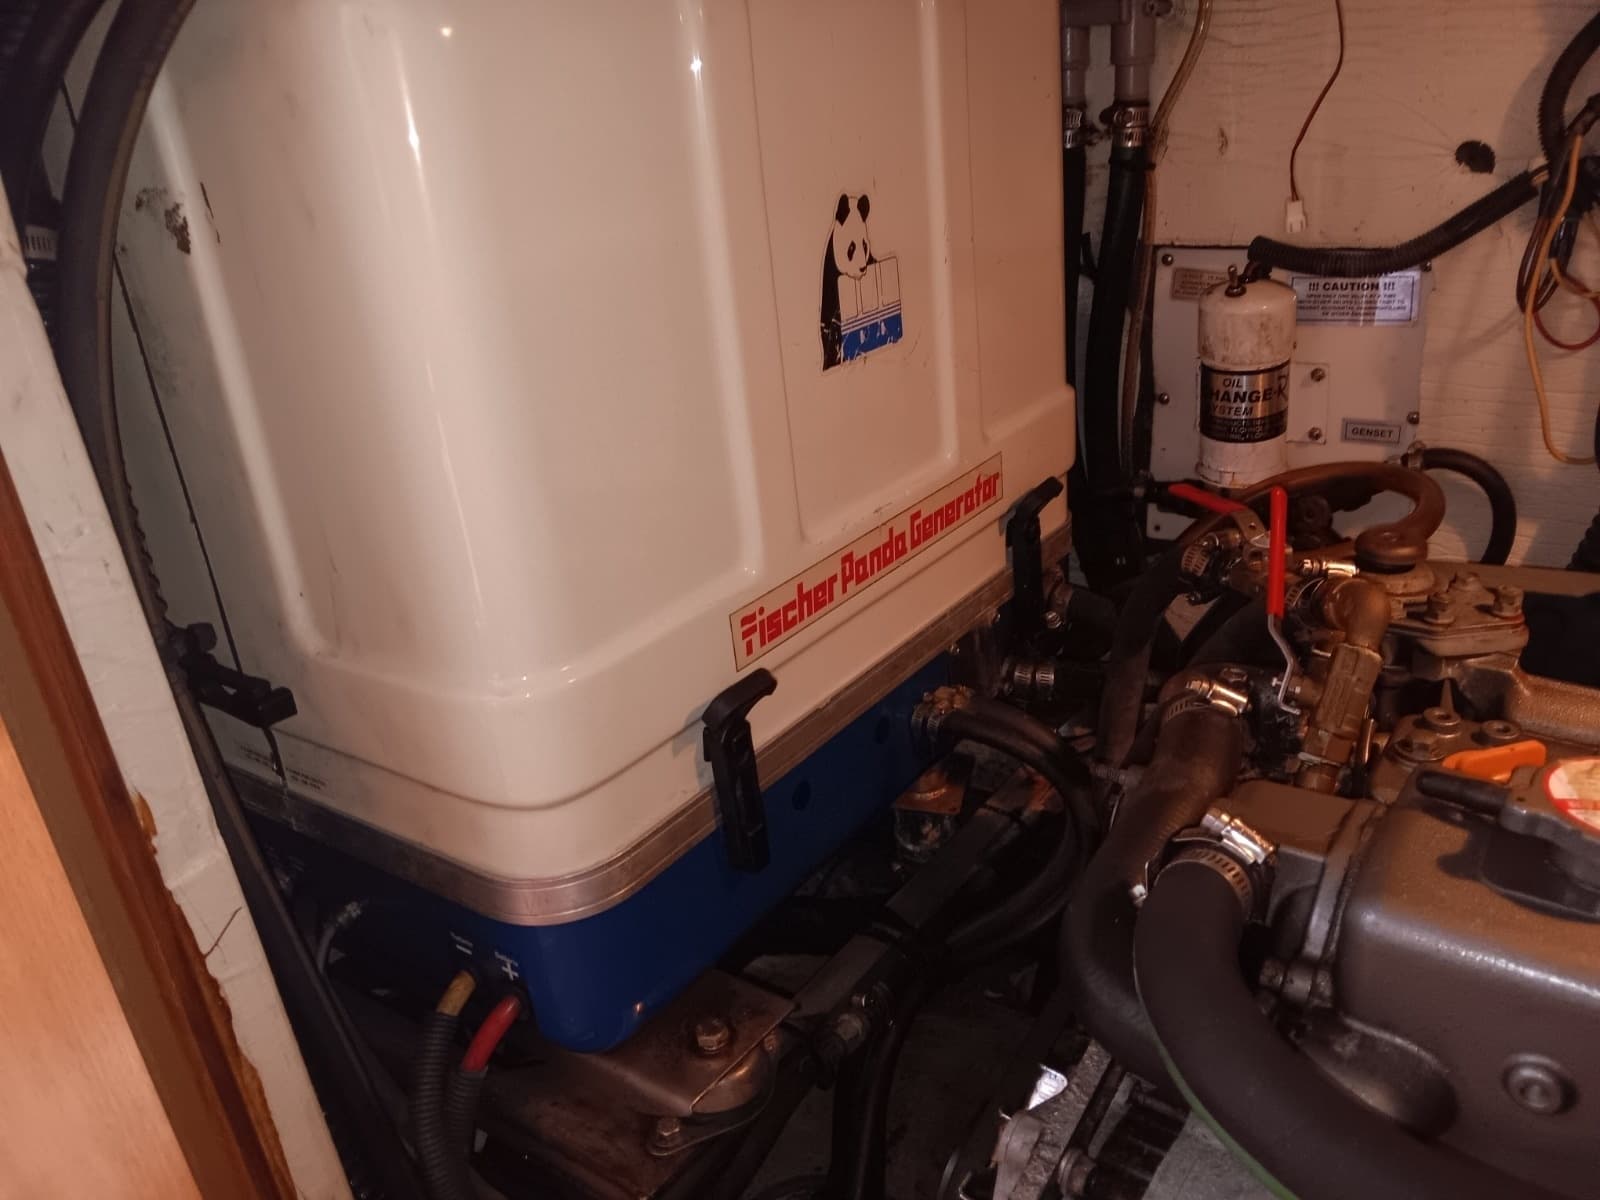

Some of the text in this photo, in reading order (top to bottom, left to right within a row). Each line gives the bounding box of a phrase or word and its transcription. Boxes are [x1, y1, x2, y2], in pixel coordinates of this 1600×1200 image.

[1322, 282, 1380, 292] CAUTION
[1223, 378, 1243, 389] OIL
[1212, 403, 1254, 417] YSTEM
[1351, 426, 1394, 438] GENSET
[740, 471, 1000, 657] Fischer Panda Generator
